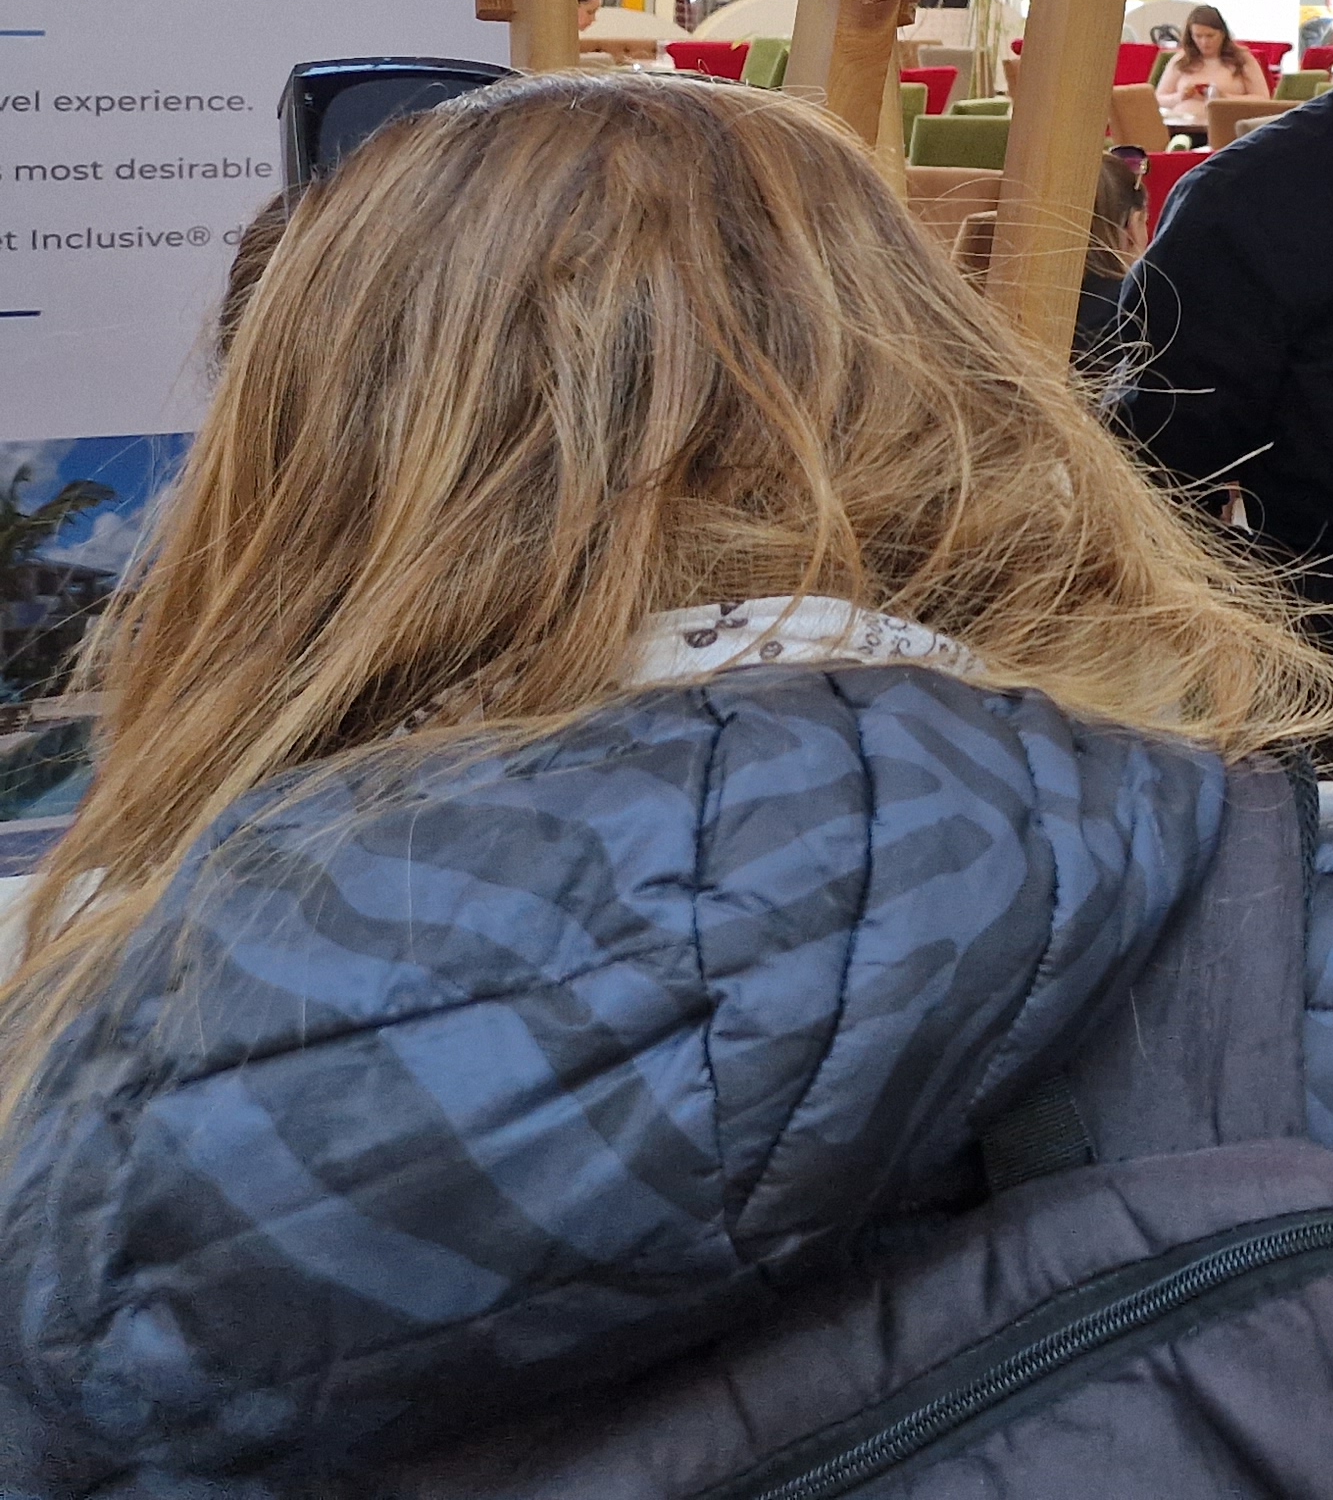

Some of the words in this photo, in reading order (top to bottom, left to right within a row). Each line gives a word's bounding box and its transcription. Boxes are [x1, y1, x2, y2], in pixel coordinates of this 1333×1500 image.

[54, 90, 253, 116] experience.
[15, 161, 103, 181] most
[115, 157, 273, 180] desirable
